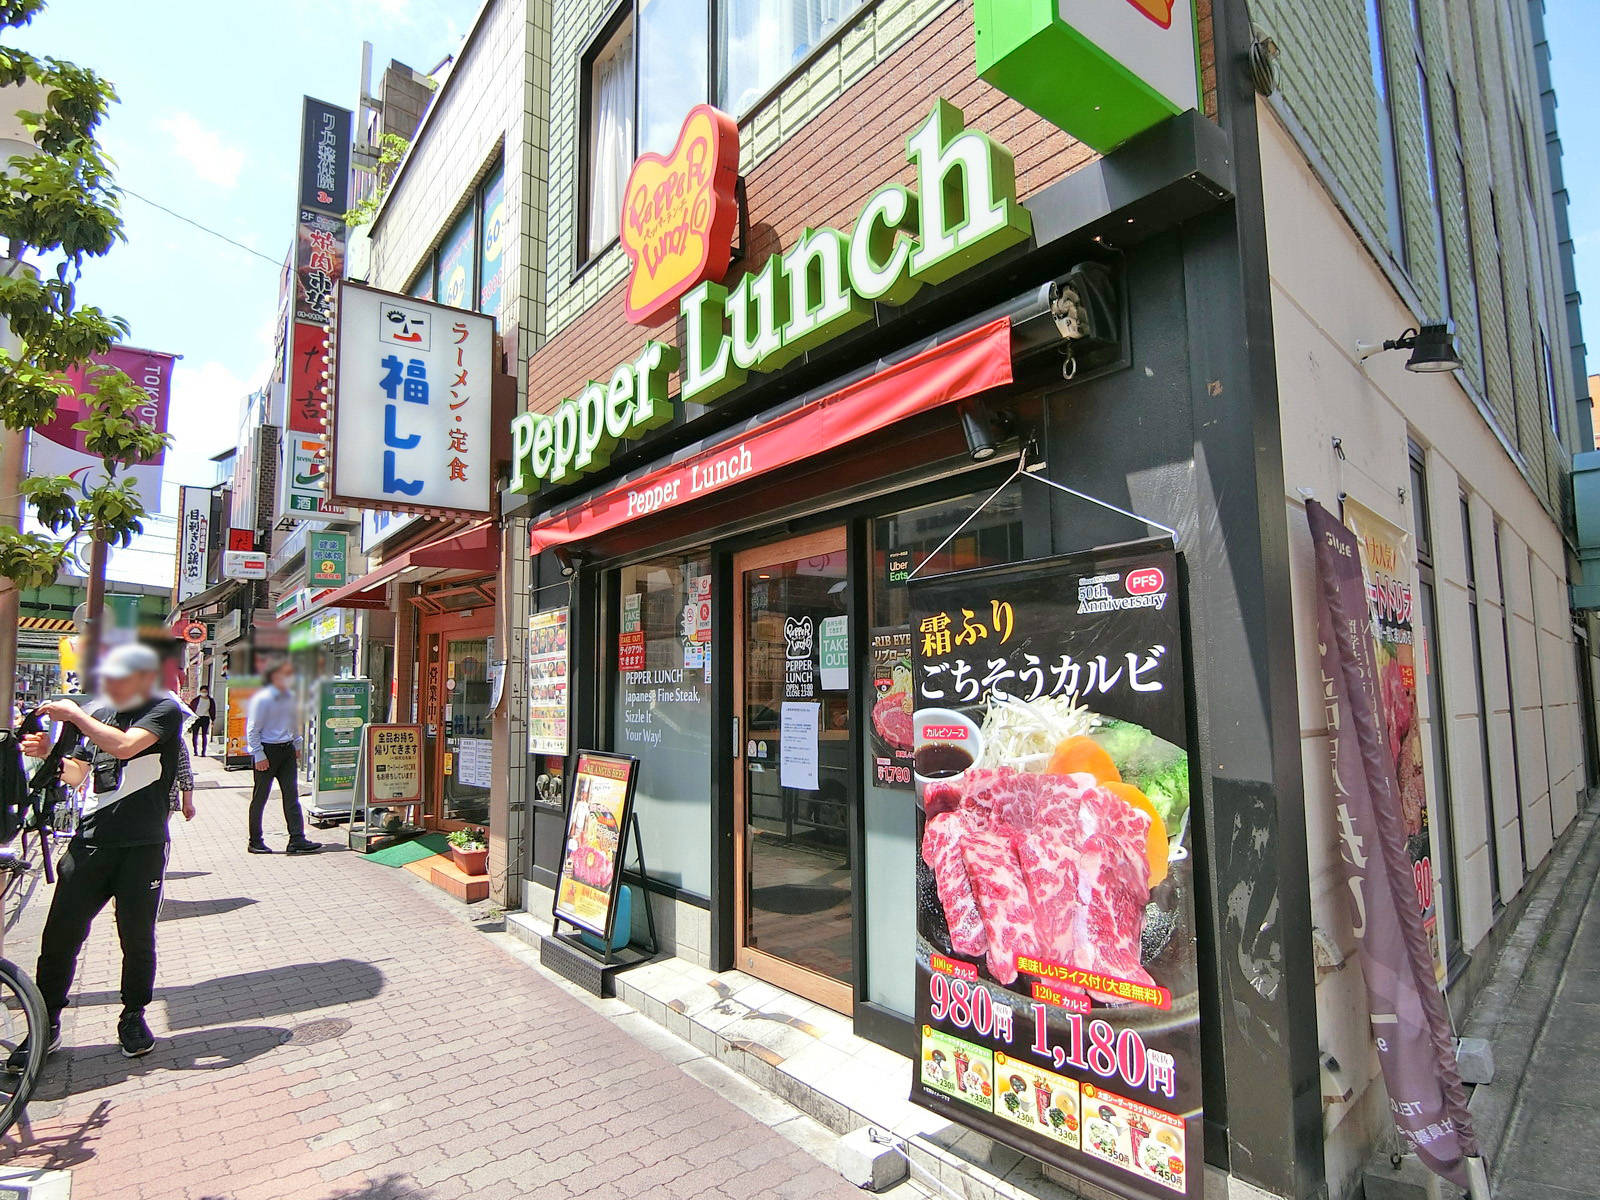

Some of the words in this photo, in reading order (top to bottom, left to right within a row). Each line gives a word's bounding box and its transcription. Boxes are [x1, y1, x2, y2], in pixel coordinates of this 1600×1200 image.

[302, 212, 315, 222] 2F
[510, 341, 663, 494] Pepper
[681, 97, 1008, 402] Lunch
[141, 366, 161, 419] TOKYO
[447, 322, 470, 482] ラーメン・定食
[379, 354, 430, 496] 福しん
[627, 479, 681, 516] Pepper
[690, 443, 753, 494] Lunch
[297, 496, 312, 510] 酒
[322, 563, 334, 572] 24
[889, 561, 909, 571] Uber
[889, 571, 909, 582] Eats
[1132, 574, 1157, 589] PFS
[1078, 584, 1108, 601] 50th
[1077, 594, 1167, 614] Anniversary
[624, 610, 640, 620] TAKE
[919, 600, 1014, 657] 霜ふり
[620, 635, 631, 643] TAKE
[632, 634, 641, 643] OUT
[823, 638, 849, 653] TAKE
[874, 635, 892, 648] RIB
[892, 633, 912, 646] EYE
[620, 645, 644, 656] テイクアウト
[874, 649, 912, 661] リブロース
[620, 656, 644, 666] できます!
[786, 660, 813, 672] PEPPER
[825, 653, 848, 666] OUT
[625, 670, 652, 685] PEPPER
[654, 669, 683, 684] LUNCH
[785, 672, 813, 683] LUNCH
[920, 645, 1166, 702] ごちそうカルビ
[428, 667, 438, 721] 営業中
[625, 689, 657, 707] Japanese
[657, 688, 674, 702] Fine
[675, 685, 701, 703] Steak,
[454, 715, 485, 735] 福しん
[625, 711, 645, 723] Sizzle
[645, 711, 652, 723] It
[378, 732, 414, 743] 全品お持ち
[625, 728, 642, 742] Your
[643, 728, 662, 748] Way!
[926, 727, 966, 738] カルビソース
[375, 744, 418, 755] 帰りできます
[933, 957, 953, 974] 100g
[953, 966, 975, 980] カルビ
[1017, 956, 1163, 1006] 美味しいライス付(大盛無料)
[1034, 984, 1061, 1005] 120g
[1061, 996, 1088, 1013] カルビ
[930, 972, 1013, 1043] 980円
[1030, 1003, 1175, 1098] 1,180円
[970, 1092, 992, 1107] +330円
[1053, 1127, 1079, 1143] +330円
[1101, 1147, 1130, 1165] +350円
[1151, 1168, 1183, 1187] +450円
